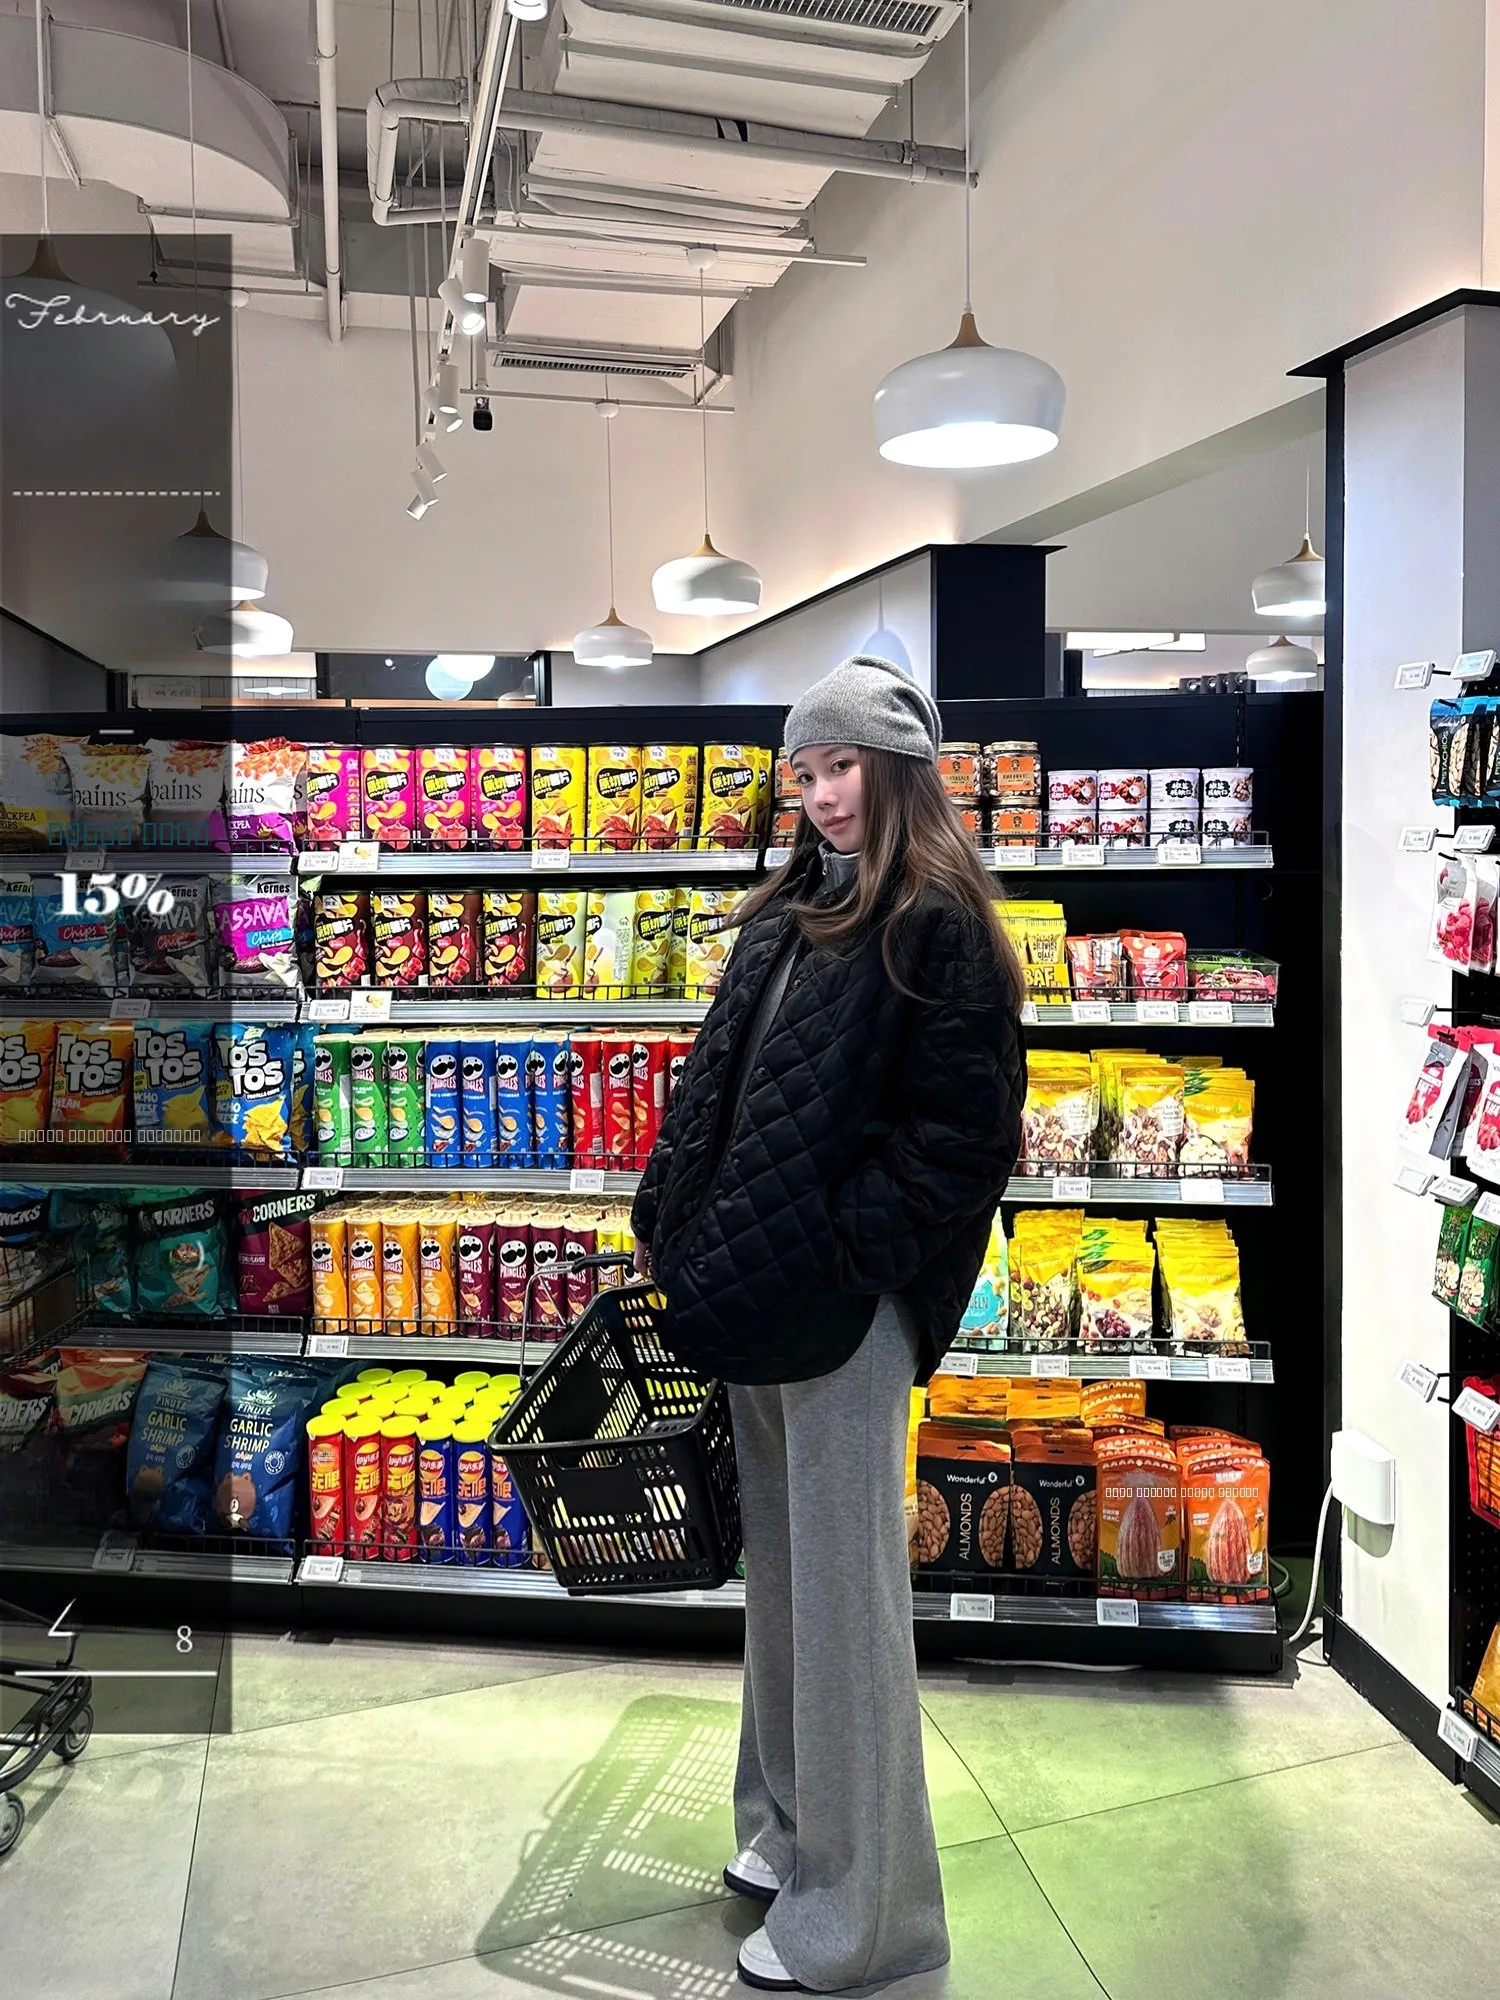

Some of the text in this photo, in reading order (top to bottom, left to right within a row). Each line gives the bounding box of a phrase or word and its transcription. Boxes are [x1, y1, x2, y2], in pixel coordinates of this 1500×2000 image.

[257, 882, 290, 894] Kernes
[63, 924, 97, 940] Chips
[251, 928, 283, 945] Chips
[59, 1035, 110, 1064] TOS
[134, 1029, 186, 1059] TOS
[217, 1041, 267, 1068] TOS
[66, 1060, 122, 1092] TOS
[145, 1051, 202, 1086] TOS
[229, 1060, 284, 1096] TOS
[253, 1194, 316, 1223] CORNERS
[69, 1391, 132, 1426] CORNERS
[237, 1403, 273, 1416] FINUTE
[147, 1411, 187, 1431] GARLIC
[230, 1418, 274, 1437] GARLIC
[140, 1427, 184, 1447] SHRIMP
[224, 1435, 270, 1453] SHRIMP
[312, 1470, 340, 1489] 无限
[457, 1477, 487, 1497] 无限
[946, 1474, 986, 1485] Wonderful
[1039, 1479, 1073, 1488] Wonderful
[959, 1492, 972, 1561] ALMONDS
[1051, 1497, 1061, 1565] ALMONDS
